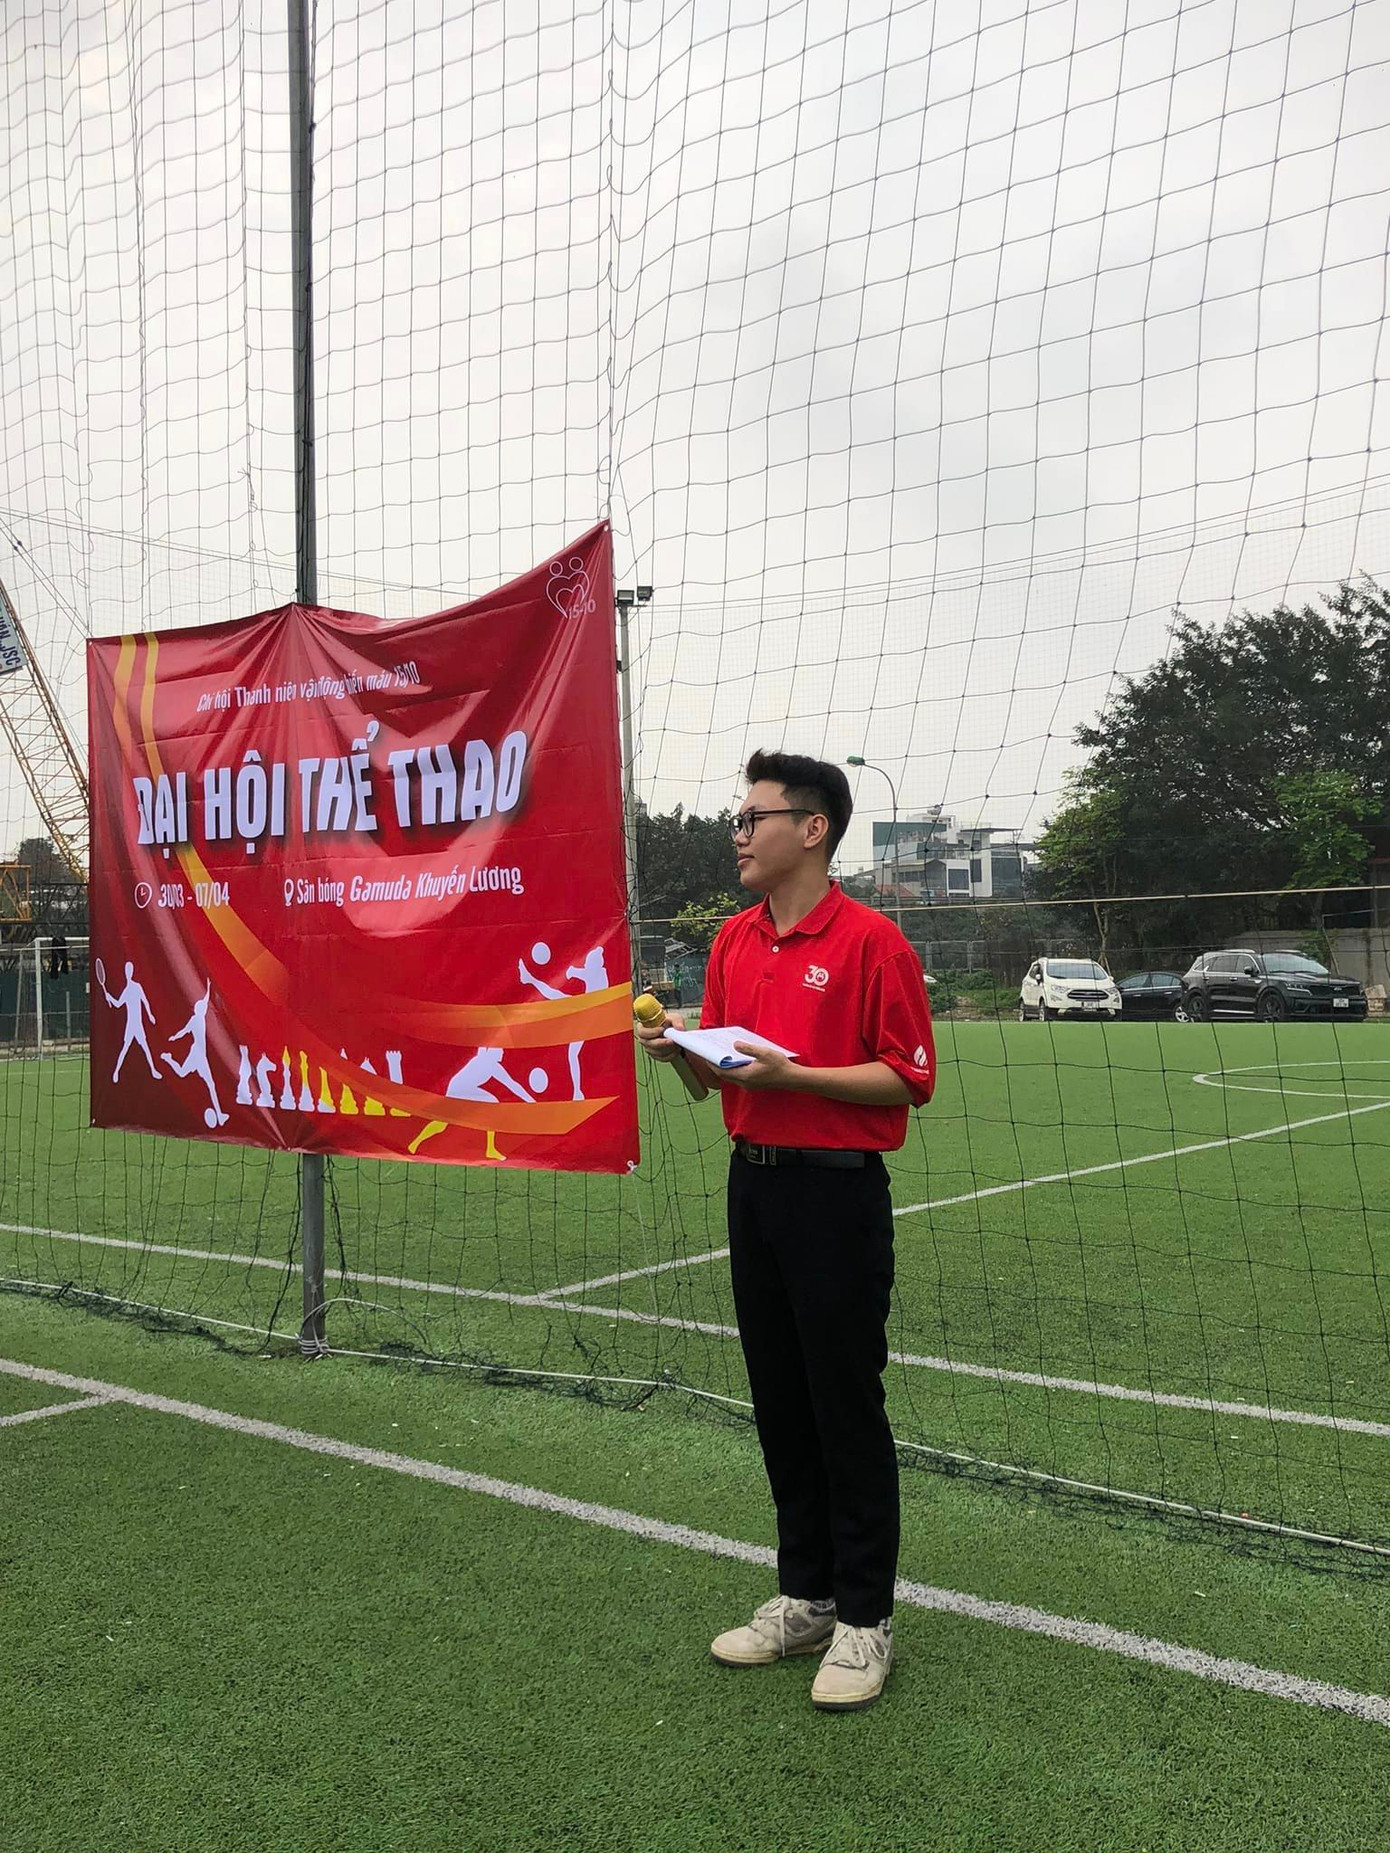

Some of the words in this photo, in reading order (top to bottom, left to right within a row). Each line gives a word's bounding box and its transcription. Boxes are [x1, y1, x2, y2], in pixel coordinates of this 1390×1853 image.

[569, 599, 596, 619] 15-10
[214, 688, 231, 712] hội
[234, 683, 271, 707] Thanh
[275, 681, 297, 702] niên
[366, 669, 393, 691] máu
[133, 771, 188, 859] ĐẠI
[204, 750, 285, 854] HỘI
[299, 720, 380, 833] THỂ
[387, 730, 527, 828] THAO
[195, 881, 230, 910] 07/04
[296, 878, 315, 905] Sân
[318, 877, 344, 907] bóng
[350, 875, 411, 902] Gamuda
[415, 864, 466, 902] Khuyến
[469, 866, 524, 895] Lương
[805, 964, 829, 986] 30
